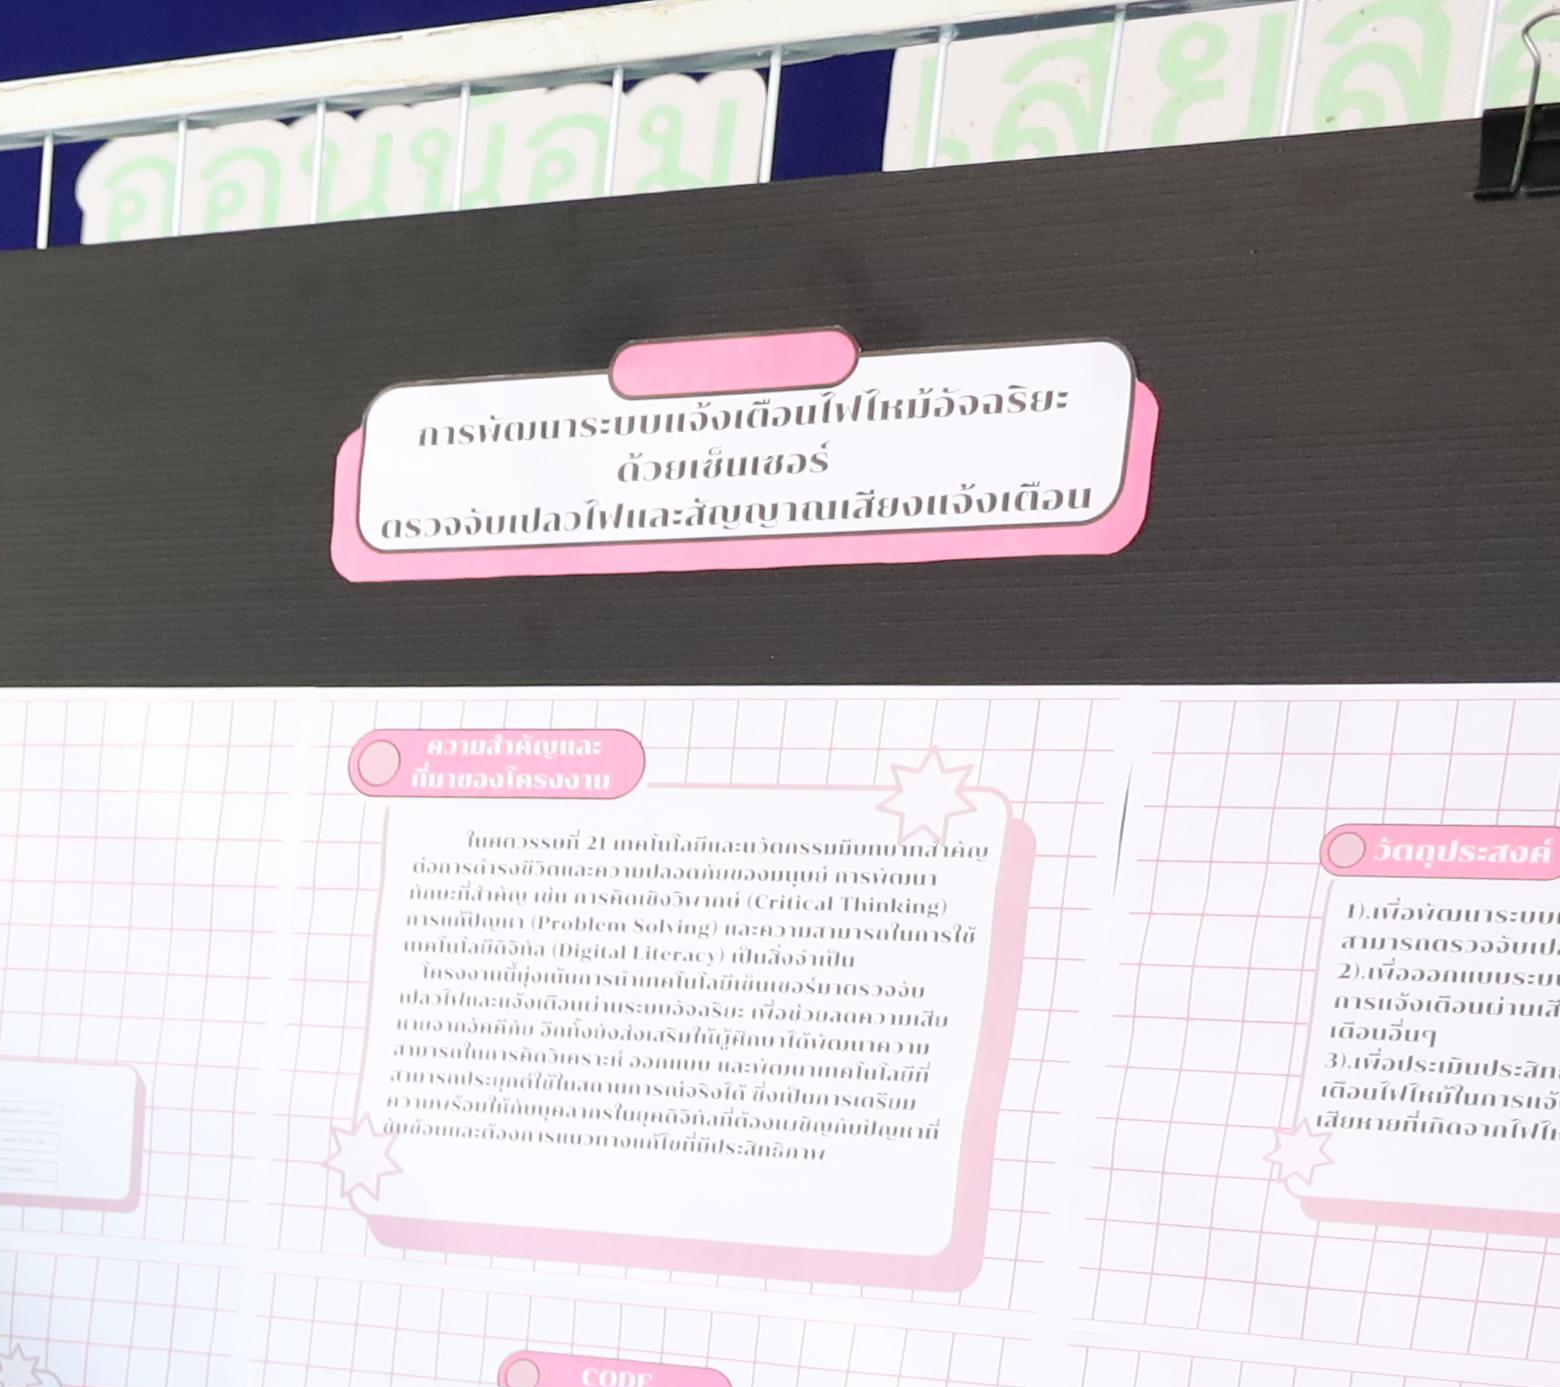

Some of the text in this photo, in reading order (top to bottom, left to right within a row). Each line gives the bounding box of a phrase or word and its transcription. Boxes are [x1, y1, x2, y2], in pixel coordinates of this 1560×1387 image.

[417, 384, 1070, 448] การพัฒนาระบบแจ้งเตือนไฟไหม้อัจฉริยะ
[616, 440, 832, 485] ด้วยเซ็นเซอร์
[381, 480, 1092, 542] ตรวจจับเปลวไฟและสัญญาณเสียงแจ้งเตือน
[427, 735, 602, 759] ความสำคัญและ
[411, 762, 611, 790] ที่มาของโครงงาน
[586, 835, 606, 851] 21
[747, 894, 833, 912] (Critical
[841, 896, 948, 917] Thinking)
[531, 914, 626, 933] (Problem
[633, 918, 718, 938] Solving)
[552, 942, 626, 963] (Digital
[633, 944, 725, 966] Literacy)
[1340, 934, 1560, 957] สามารถตรวจจับเป
[1324, 1047, 1560, 1081] 3).เพื่อประเมินประสิท
